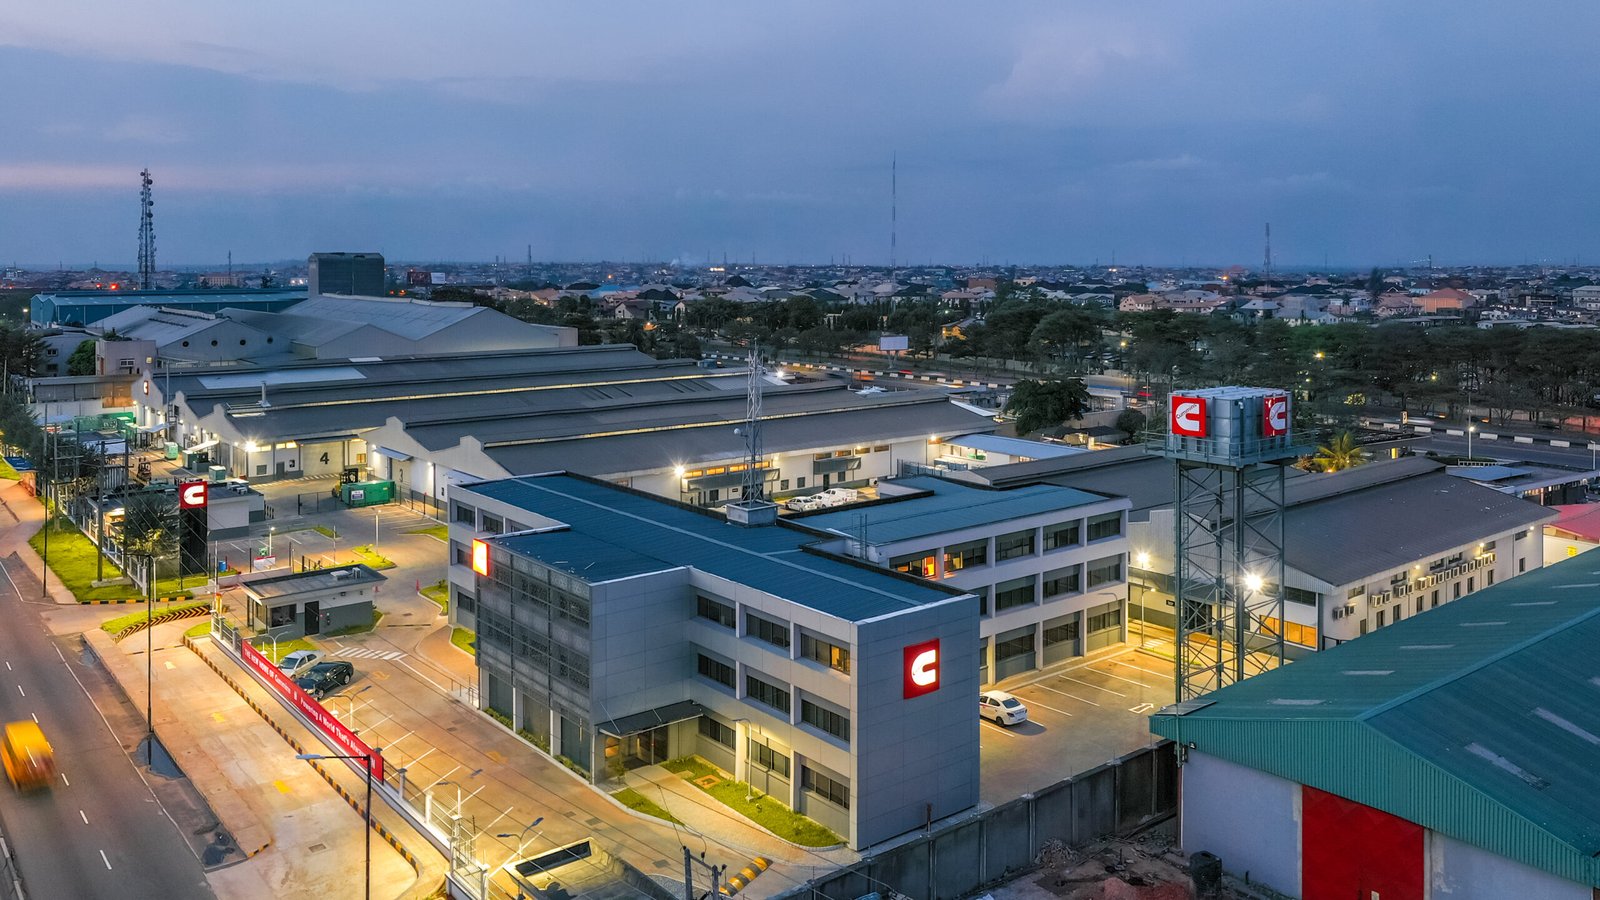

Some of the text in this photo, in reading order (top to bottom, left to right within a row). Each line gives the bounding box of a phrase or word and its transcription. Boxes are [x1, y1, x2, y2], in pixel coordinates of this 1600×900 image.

[320, 452, 329, 464] 4
[251, 655, 259, 666] NEW
[259, 661, 269, 675] HOME
[269, 670, 275, 679] OF
[301, 697, 319, 721] Powering
[323, 716, 336, 733] World
[336, 727, 350, 746] That's
